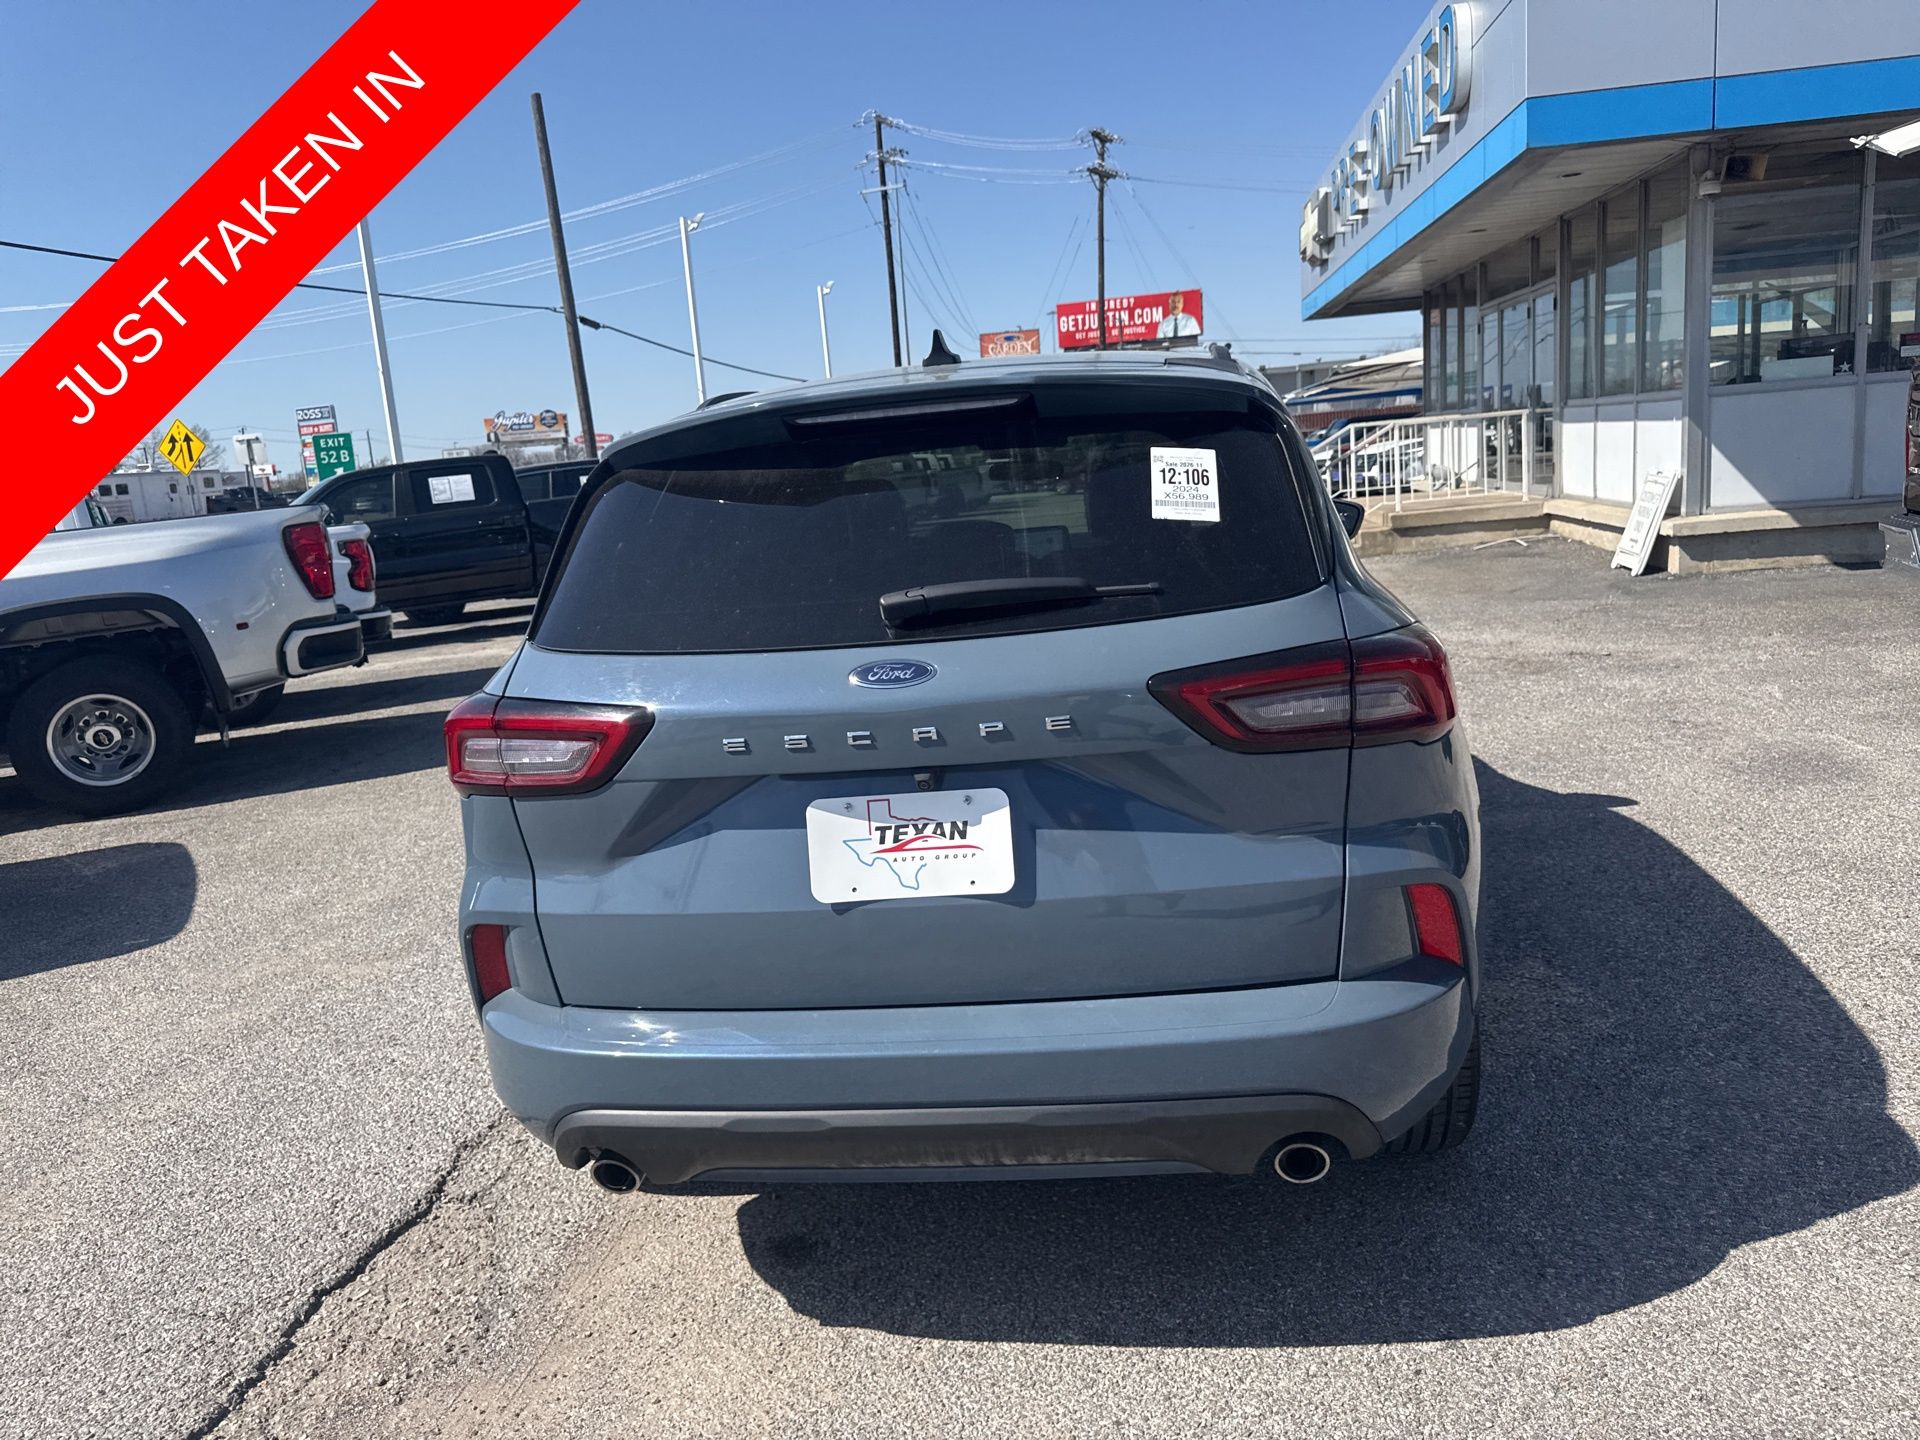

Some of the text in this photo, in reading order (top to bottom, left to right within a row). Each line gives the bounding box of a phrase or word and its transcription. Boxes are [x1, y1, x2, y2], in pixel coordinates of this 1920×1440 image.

[1060, 306, 1164, 332] GETJUTIN.COM
[297, 409, 322, 420] ROSS
[320, 437, 345, 448] EXIT
[320, 449, 350, 465] 52 B
[1159, 467, 1210, 486] 12:106
[1172, 485, 1199, 493] 2024
[868, 663, 916, 681] Ford
[722, 714, 1073, 752] ESCAPE
[874, 820, 969, 845] TEXAN
[892, 852, 977, 863] AUTO GROUP
